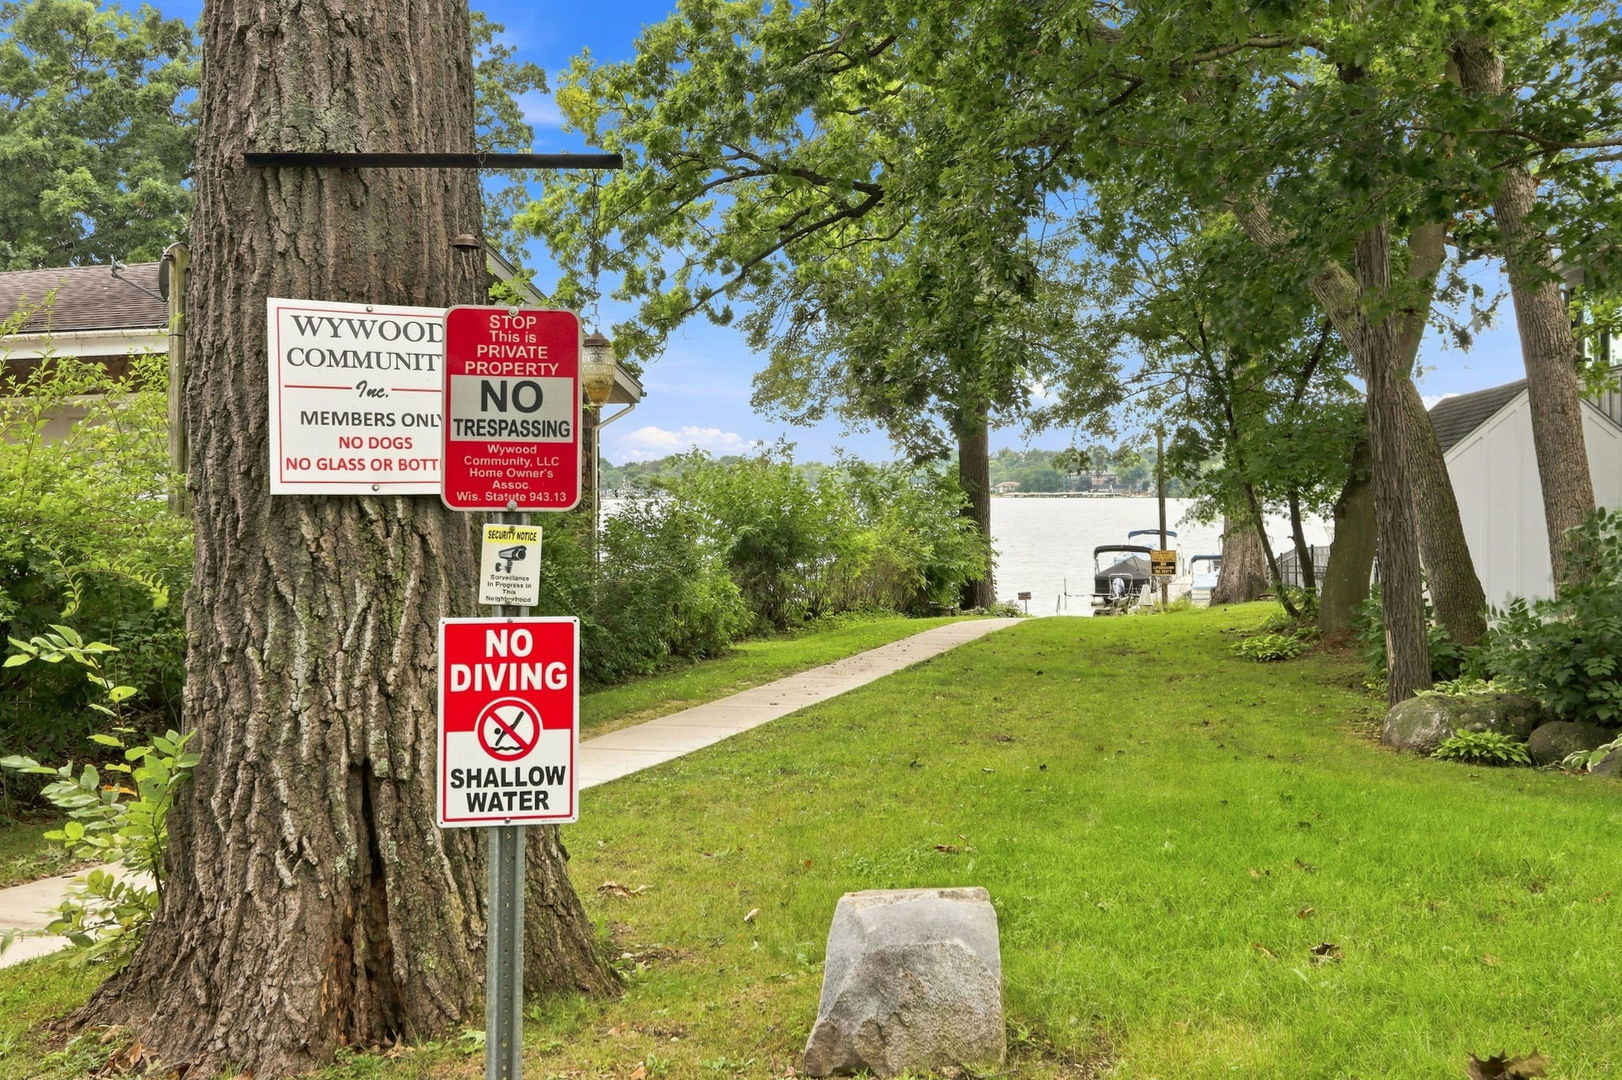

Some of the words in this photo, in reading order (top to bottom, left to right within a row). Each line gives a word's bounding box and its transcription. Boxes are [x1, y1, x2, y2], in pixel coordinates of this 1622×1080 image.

[291, 315, 443, 343] WYWOOD
[489, 315, 537, 329] STOP
[489, 330, 520, 343] This
[525, 331, 537, 343] is
[477, 344, 548, 359] PRIVATE
[287, 348, 442, 371] COMMUNIT
[465, 361, 559, 376] PROPERTY
[355, 380, 389, 398] Inc.
[481, 379, 544, 414] NO
[300, 411, 396, 427] MEMBERS
[453, 418, 571, 438] TRESPASSING
[339, 436, 363, 449] NO
[368, 437, 413, 449] DOGS
[487, 444, 537, 456] Wywood
[286, 458, 311, 471] NO
[316, 458, 366, 471] GLASS
[370, 459, 393, 471] OR
[399, 459, 442, 471] BOTT
[464, 456, 533, 468] Community,
[537, 457, 560, 466] LLC
[469, 468, 503, 478] Home
[506, 468, 554, 478] Owner's
[492, 480, 531, 489] Assoc.
[456, 491, 481, 501] Wis.
[485, 491, 527, 502] Statute
[529, 492, 567, 502] 943.13
[488, 530, 516, 540] SECURITY
[516, 531, 537, 542] NOTICE
[495, 581, 524, 589] Progress
[485, 628, 534, 658] NO
[450, 661, 568, 693] DIVING
[450, 765, 566, 789] SHALLOW
[466, 790, 550, 813] WATER
